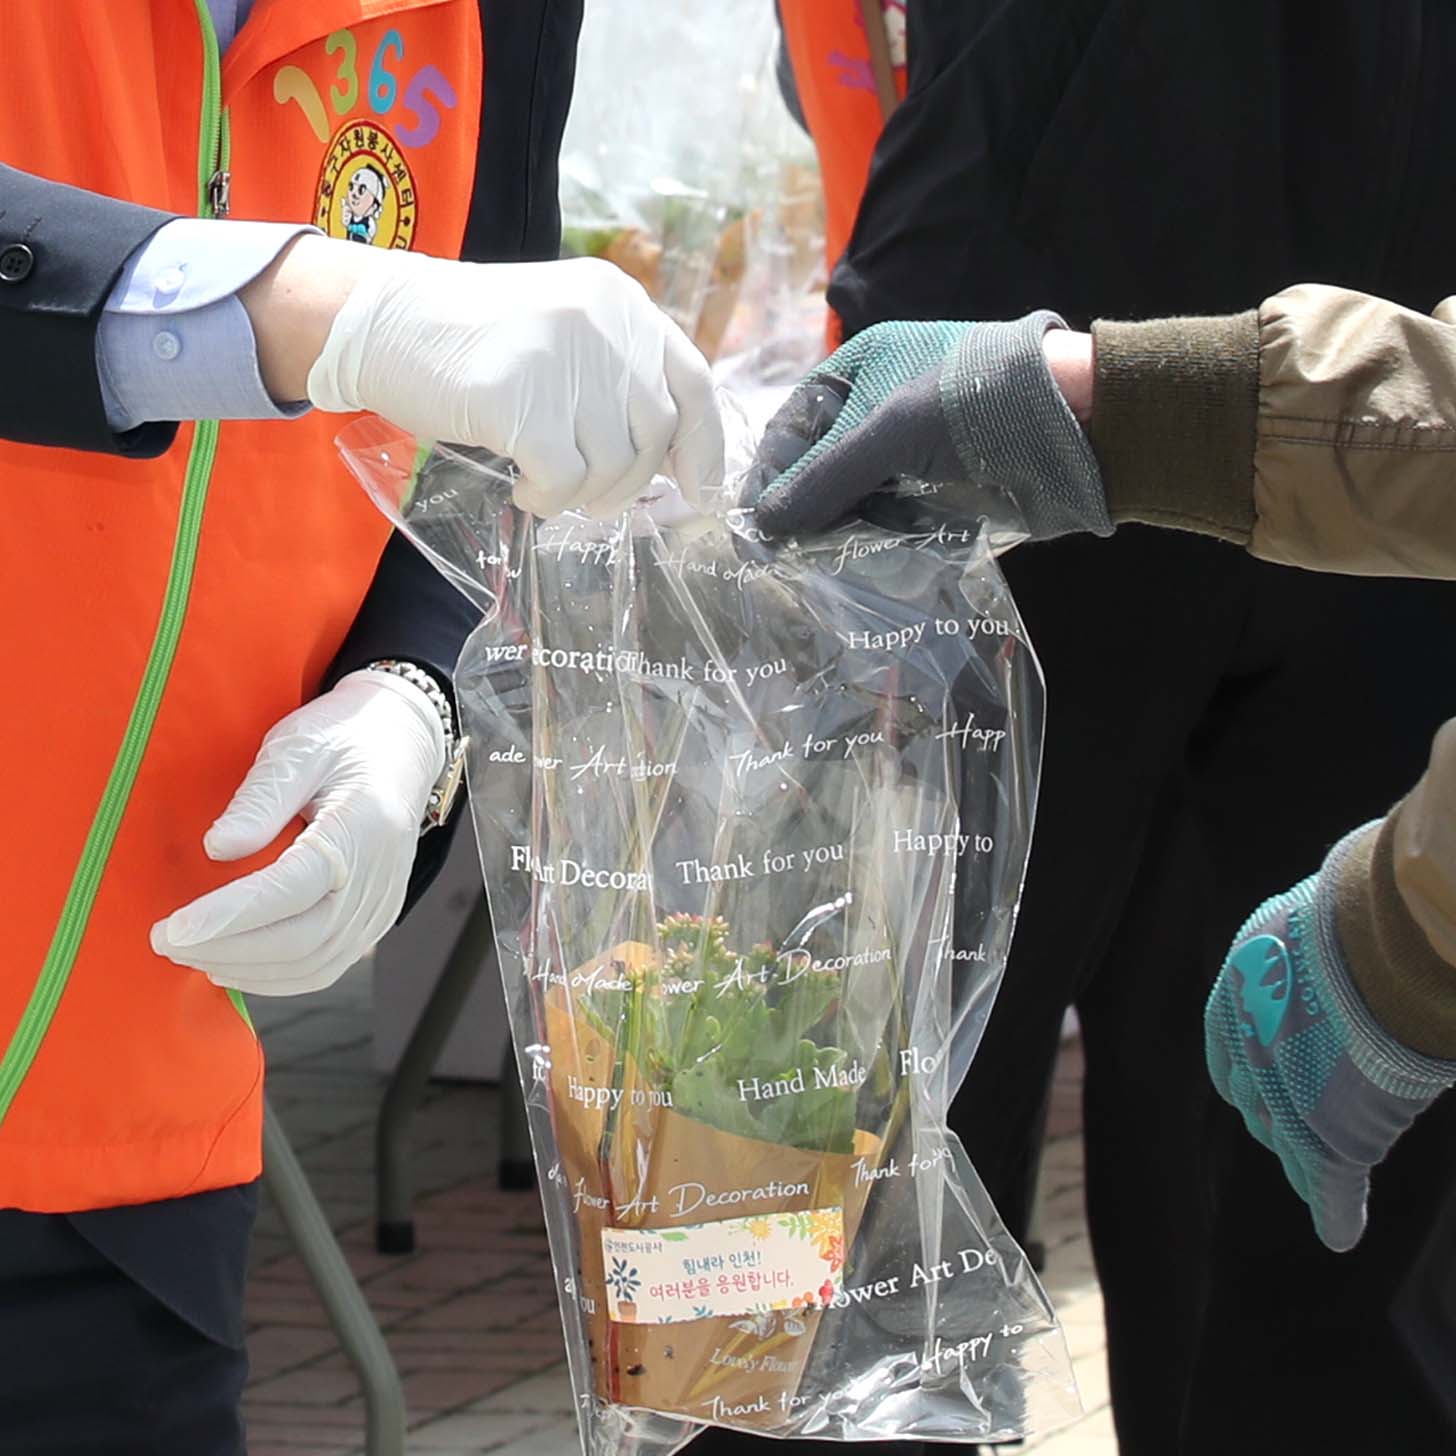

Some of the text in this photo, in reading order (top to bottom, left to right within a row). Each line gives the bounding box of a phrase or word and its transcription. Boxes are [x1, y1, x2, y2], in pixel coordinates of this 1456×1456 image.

[273, 28, 458, 148] 1365
[848, 614, 1009, 650] Happy to you
[704, 659, 737, 683] for
[747, 658, 787, 688] you
[729, 730, 885, 778] Thank for you
[894, 828, 994, 858] Happy to
[676, 842, 844, 886] Thank for you
[712, 957, 769, 1000] Art
[775, 946, 893, 987] Decoration
[567, 1074, 624, 1111] Happy
[737, 1059, 868, 1103] Hand Made
[850, 1156, 901, 1189] Thank
[908, 1152, 938, 1177] for
[668, 1181, 811, 1219] Decoration
[682, 1250, 762, 1276] 힘내라 인천!
[910, 1261, 954, 1289] Art
[649, 1268, 795, 1303] 여러분을 응원합니다.
[999, 1322, 1024, 1339] to
[701, 1394, 771, 1422] Thank
[779, 1390, 811, 1411] for
